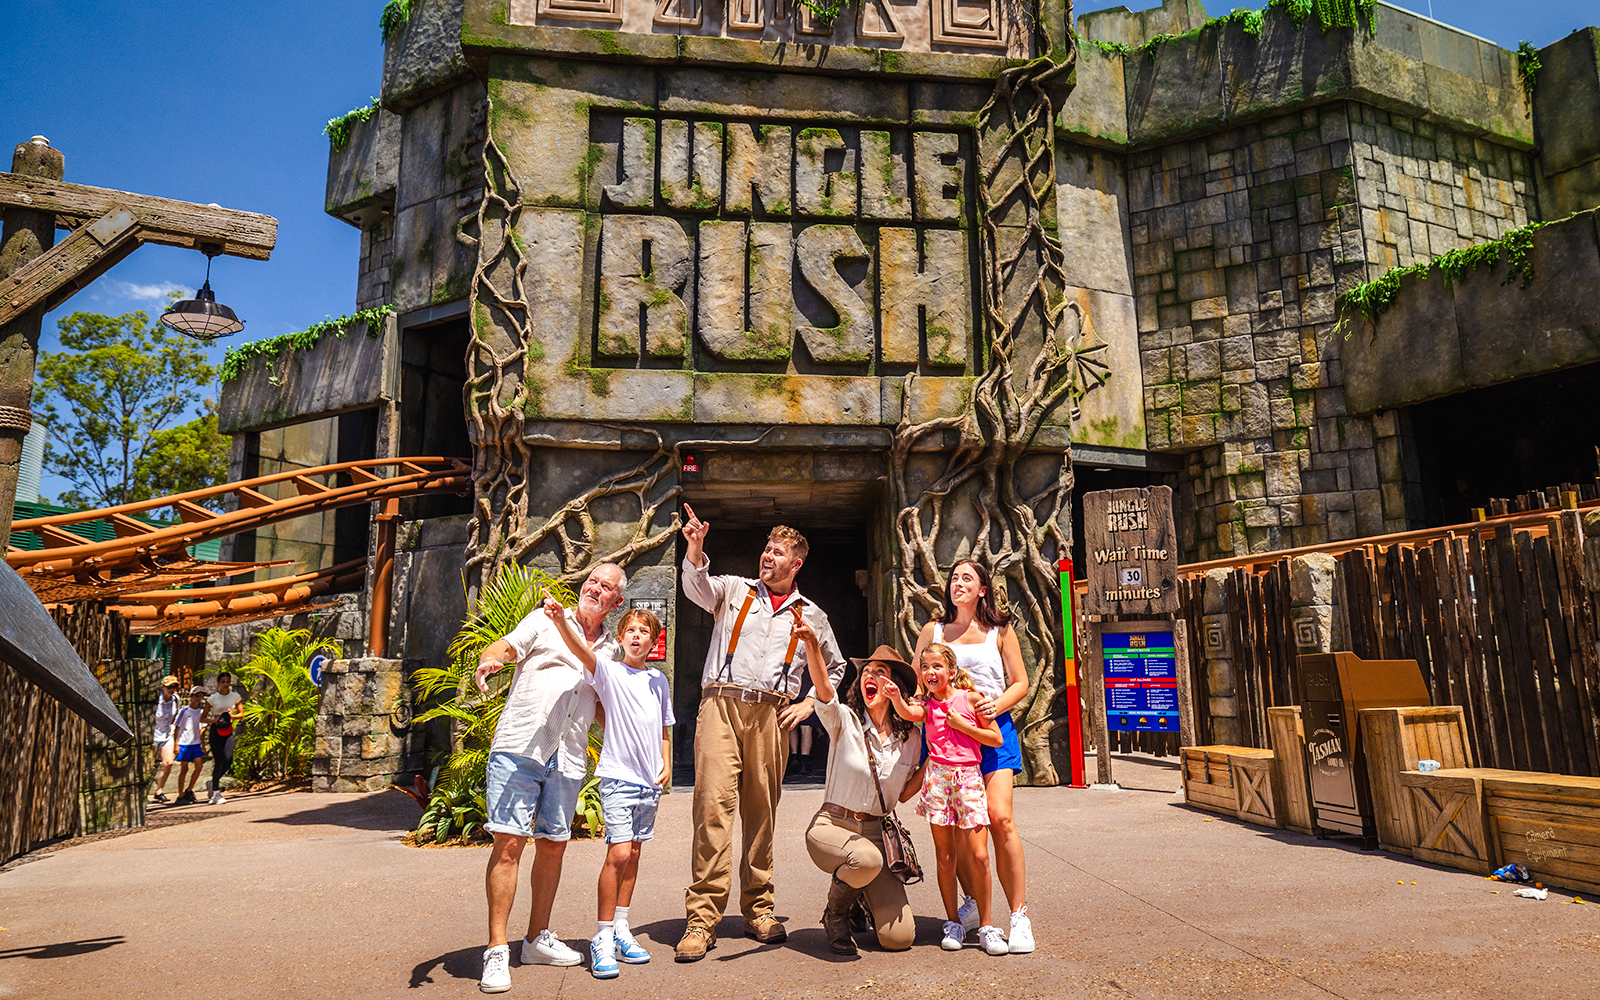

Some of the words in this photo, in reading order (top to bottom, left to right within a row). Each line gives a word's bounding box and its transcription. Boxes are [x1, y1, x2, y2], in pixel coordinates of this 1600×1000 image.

[602, 117, 962, 222] JUNGLE
[598, 214, 967, 366] RUSH
[1107, 498, 1148, 513] JUNGLE
[1107, 511, 1148, 531] RUSH
[1094, 547, 1128, 564] Wait
[1131, 545, 1168, 560] Time
[1126, 570, 1140, 581] 30
[1105, 586, 1161, 601] minutes
[636, 602, 650, 610] SKIP
[651, 602, 661, 610] THE
[1308, 672, 1330, 687] PUSH
[1309, 738, 1342, 765] TASMAN
[1525, 827, 1555, 842] Camera
[1525, 846, 1567, 862] Equipment
